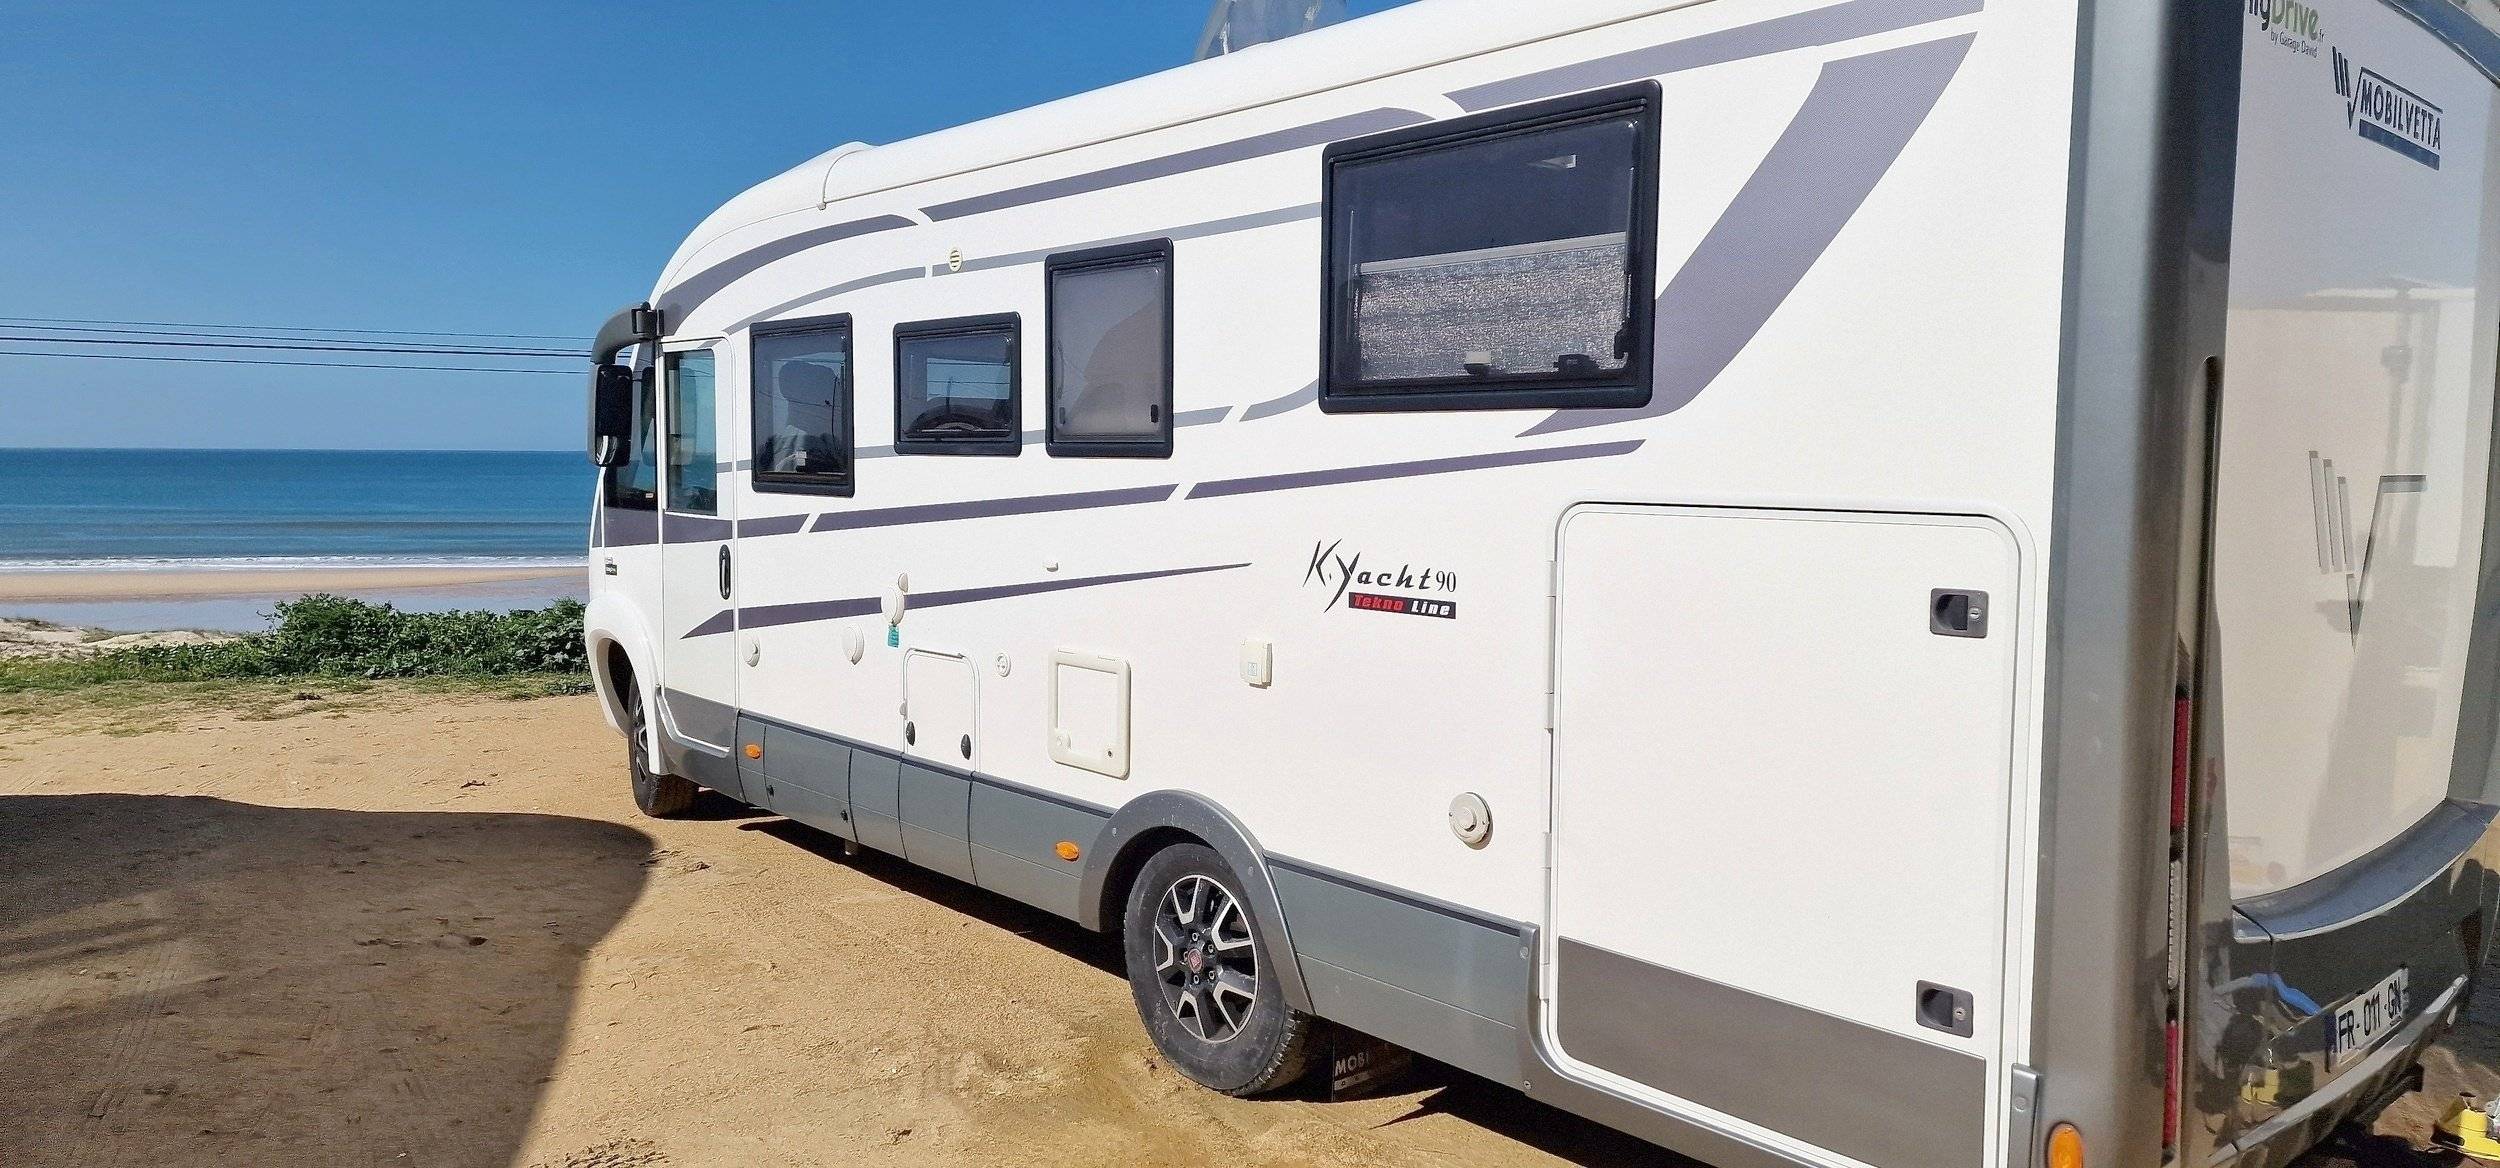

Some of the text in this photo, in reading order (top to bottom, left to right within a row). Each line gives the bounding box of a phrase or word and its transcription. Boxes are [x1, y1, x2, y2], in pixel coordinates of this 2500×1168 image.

[2360, 78, 2441, 150] MOBILVETTA
[1435, 570, 1457, 593] 90
[1410, 599, 1451, 616] Line
